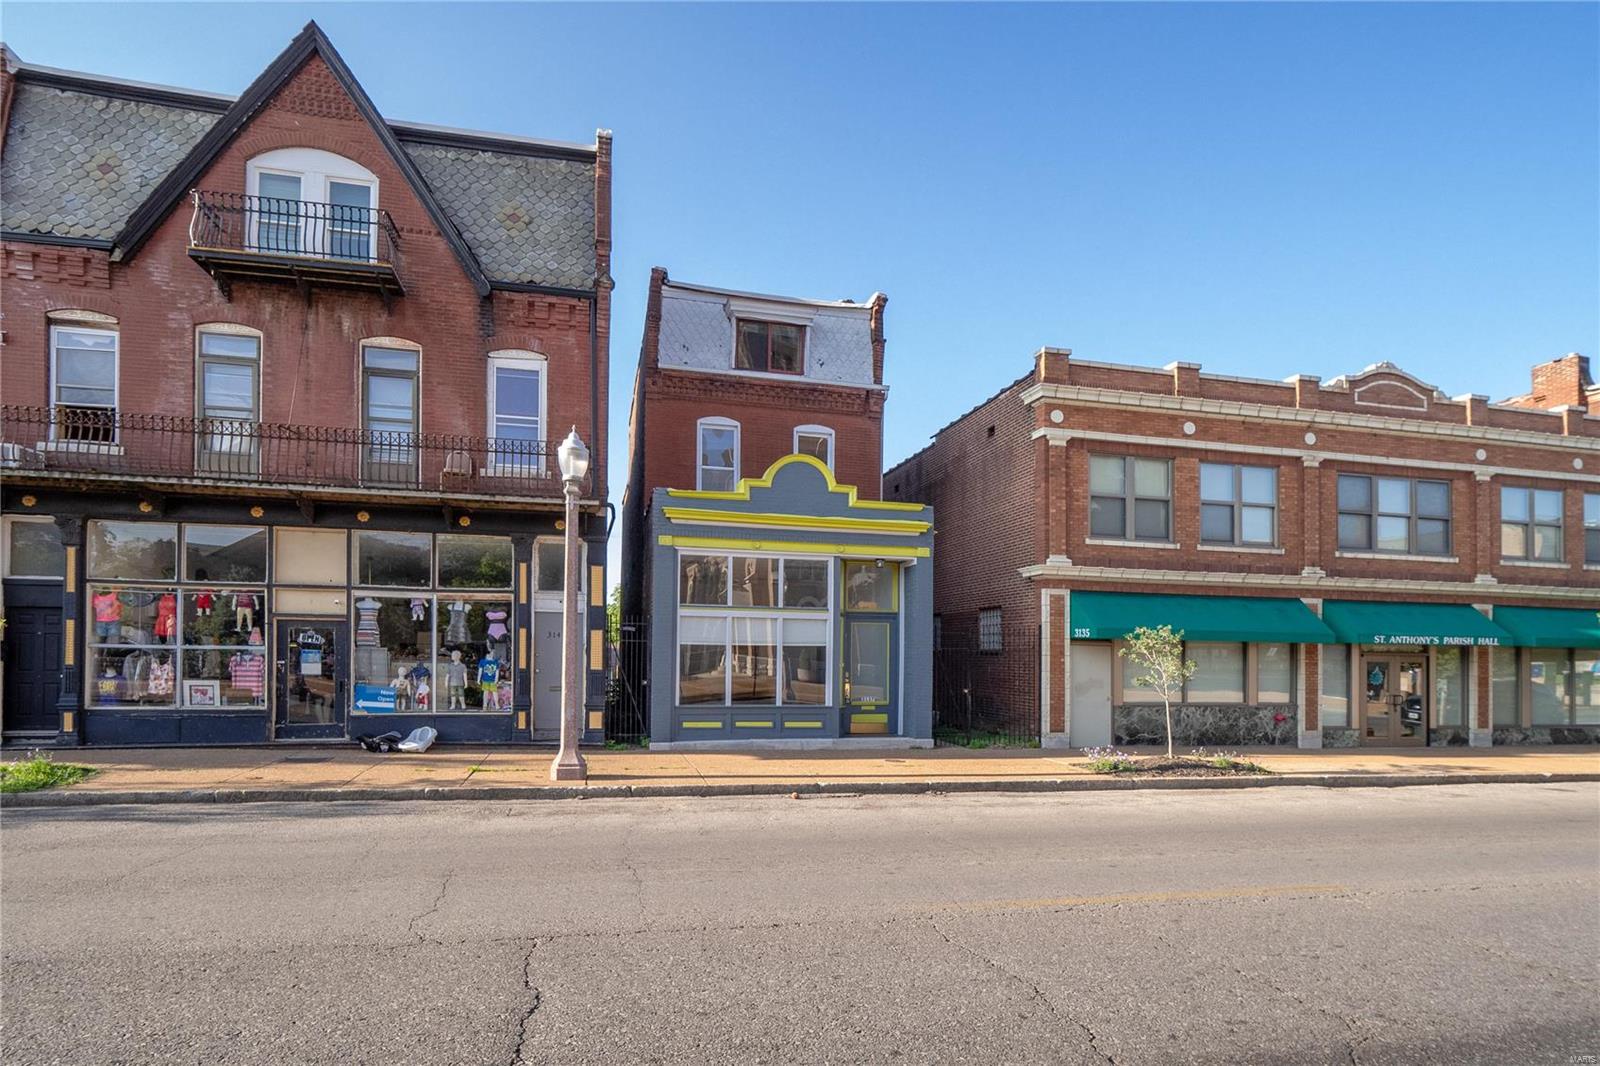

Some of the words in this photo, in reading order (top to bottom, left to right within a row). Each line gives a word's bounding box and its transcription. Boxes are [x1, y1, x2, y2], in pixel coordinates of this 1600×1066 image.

[1074, 629, 1090, 638] 3135
[301, 634, 319, 643] OPEN
[1374, 635, 1387, 644] ST.
[1389, 636, 1440, 645] ANTHONY'S
[1443, 637, 1474, 646] PARISH
[1477, 638, 1500, 646] HALL
